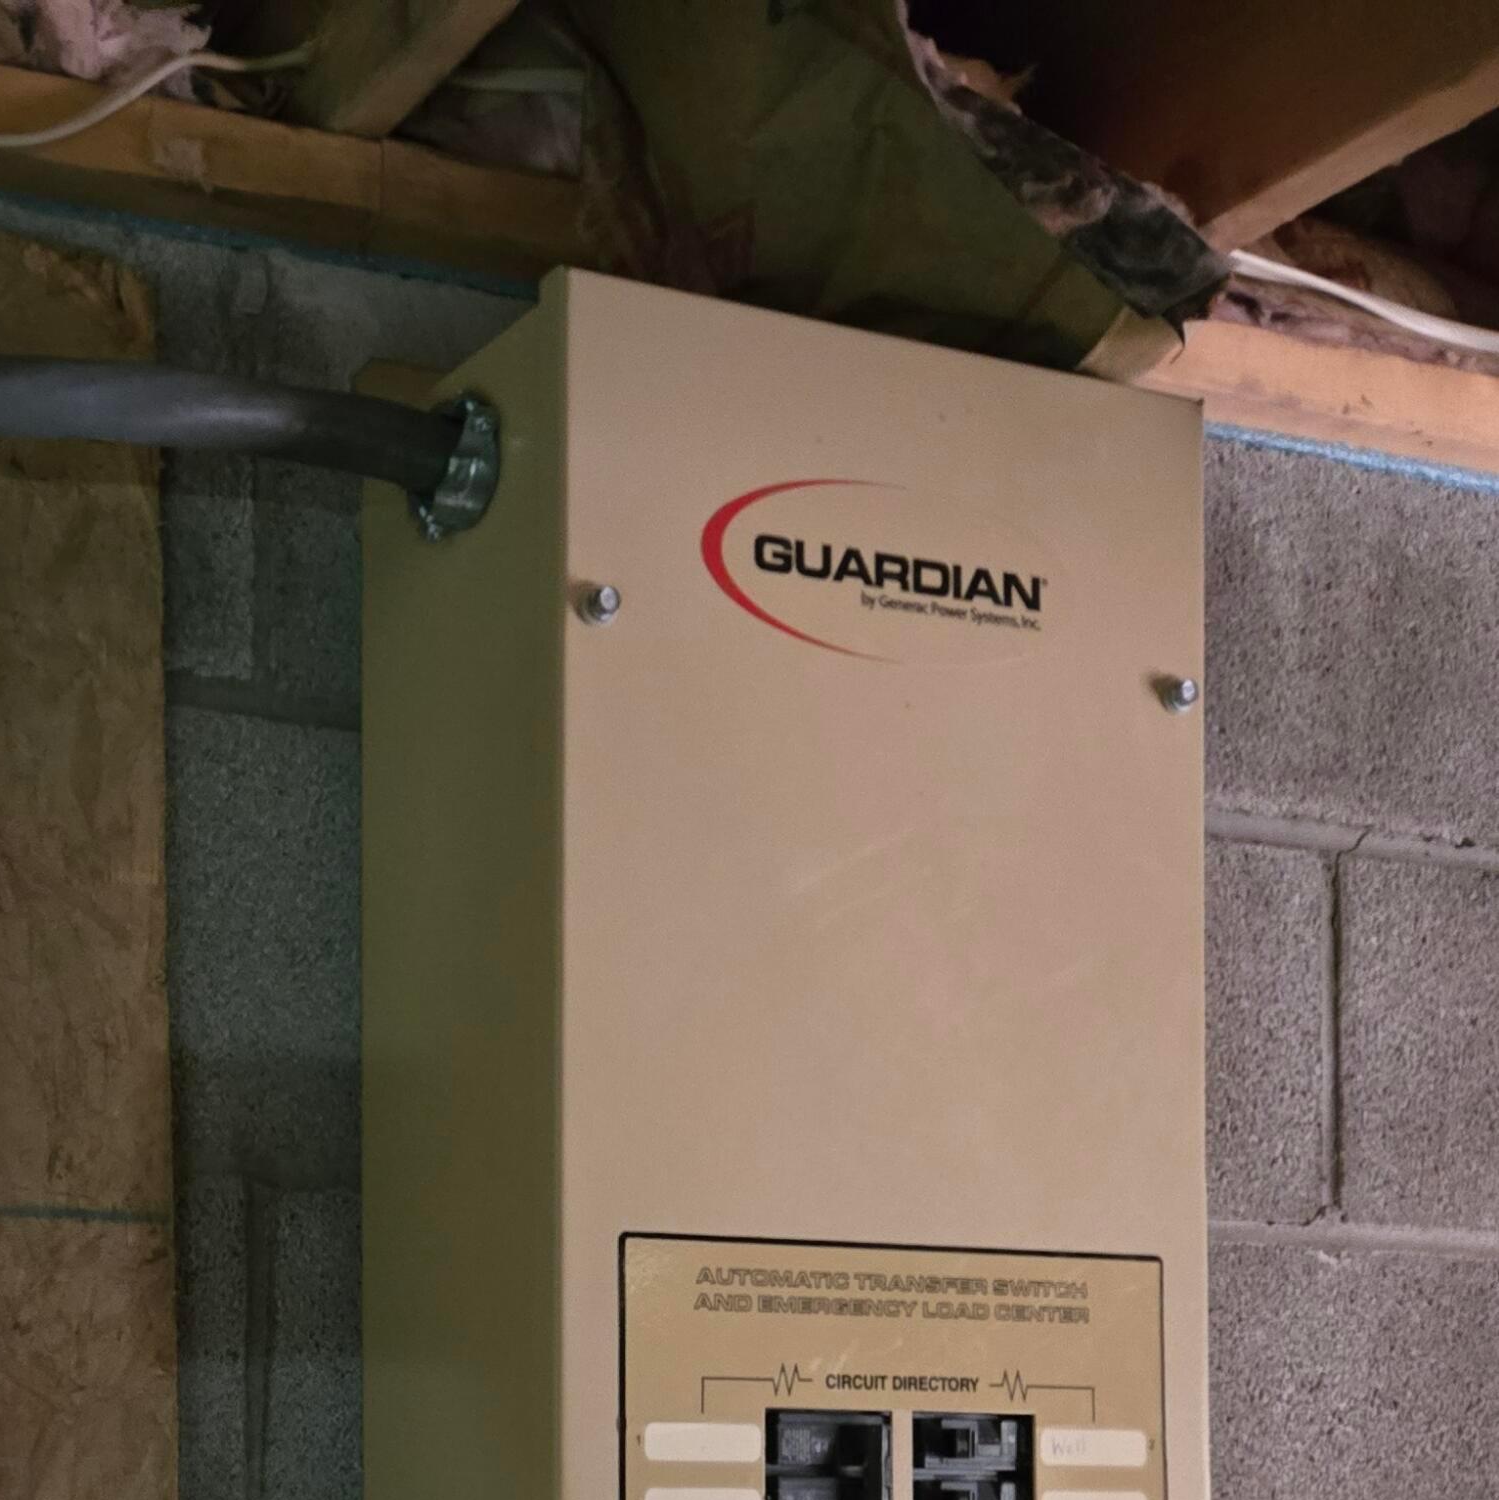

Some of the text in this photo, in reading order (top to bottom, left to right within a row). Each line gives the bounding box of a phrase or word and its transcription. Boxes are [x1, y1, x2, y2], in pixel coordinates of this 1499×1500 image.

[754, 534, 1041, 611] GUARDIAN
[861, 591, 876, 610] by
[879, 595, 928, 616] Generac
[931, 602, 968, 620] Power
[696, 1267, 1088, 1299] AUTOMATIC TRANSFER SWITCH
[694, 1293, 1090, 1324] AND EMERGENCY LOAD CENTER
[825, 1373, 979, 1393] CIRCUIT DIRECTORY
